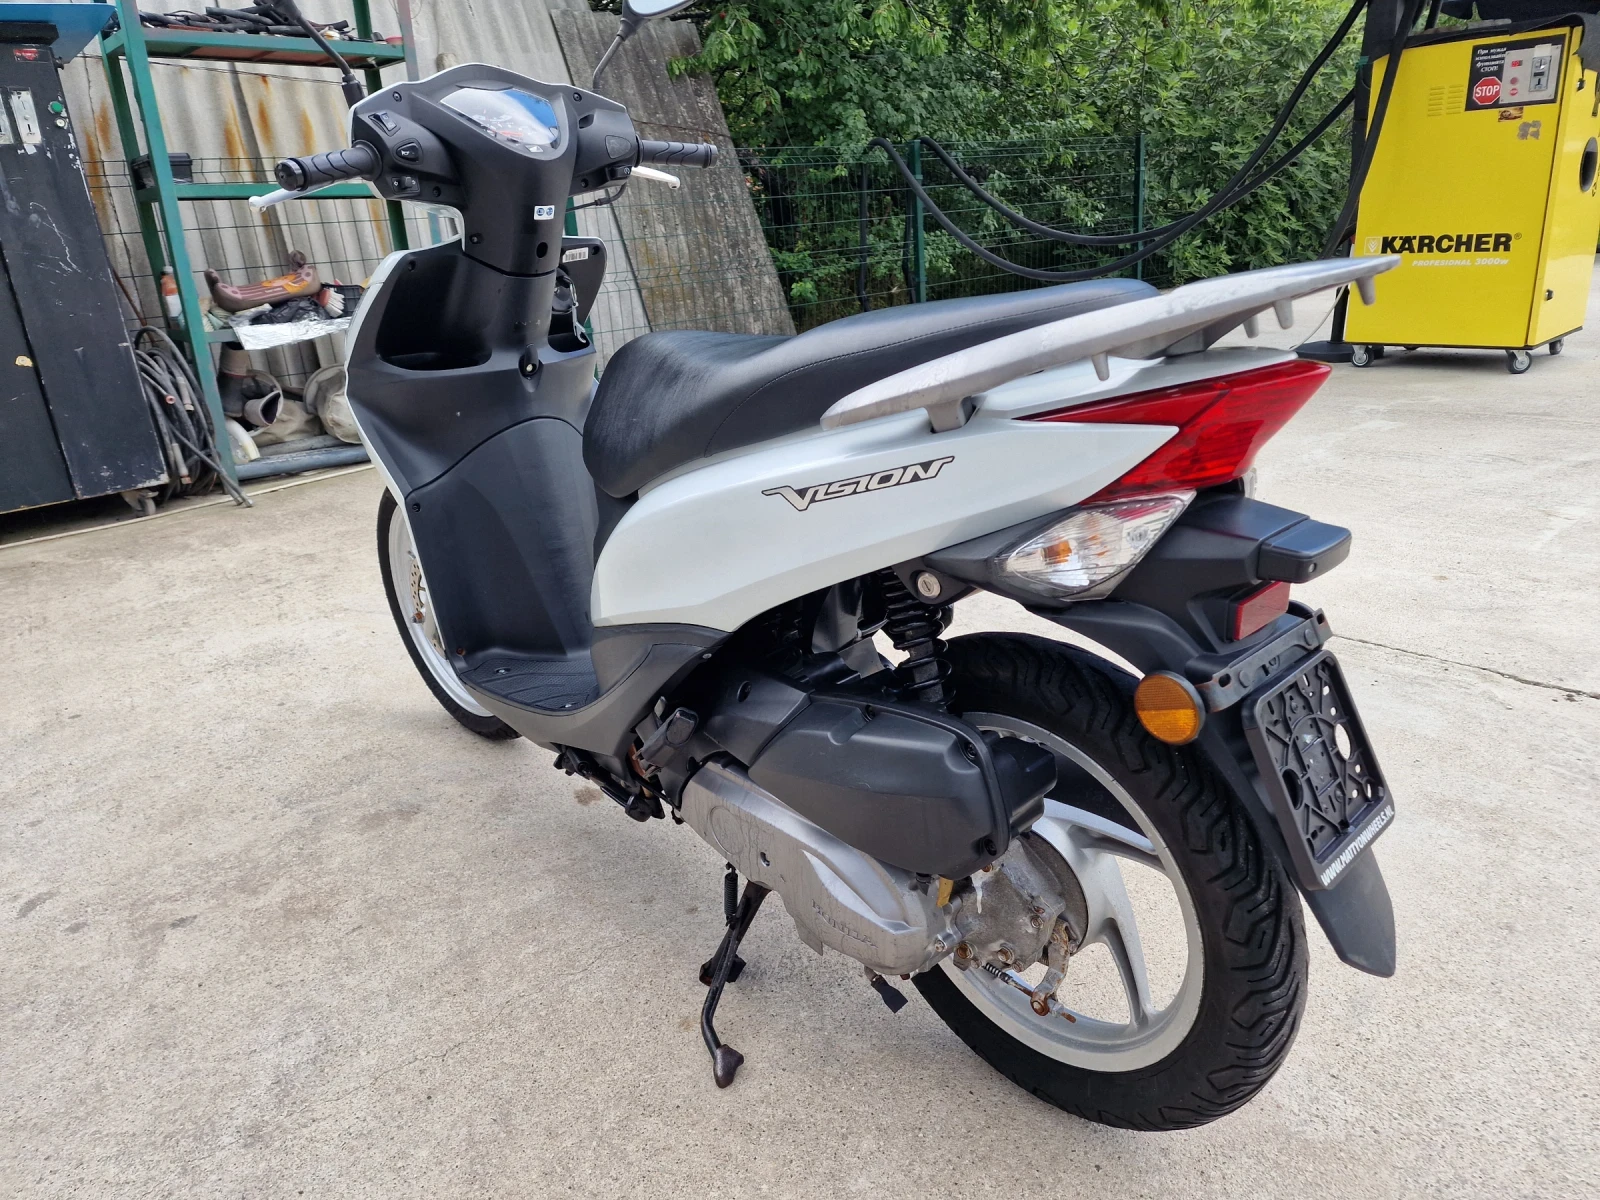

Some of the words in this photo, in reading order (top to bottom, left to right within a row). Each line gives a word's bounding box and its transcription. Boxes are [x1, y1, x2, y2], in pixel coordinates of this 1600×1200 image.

[1475, 85, 1500, 97] STOP
[1380, 233, 1513, 254] KÄRCHER
[1412, 259, 1472, 267] PROFESIONAL
[761, 456, 955, 512] VISION
[1320, 805, 1395, 887] WWW.MATTYONWHEELS.NL
